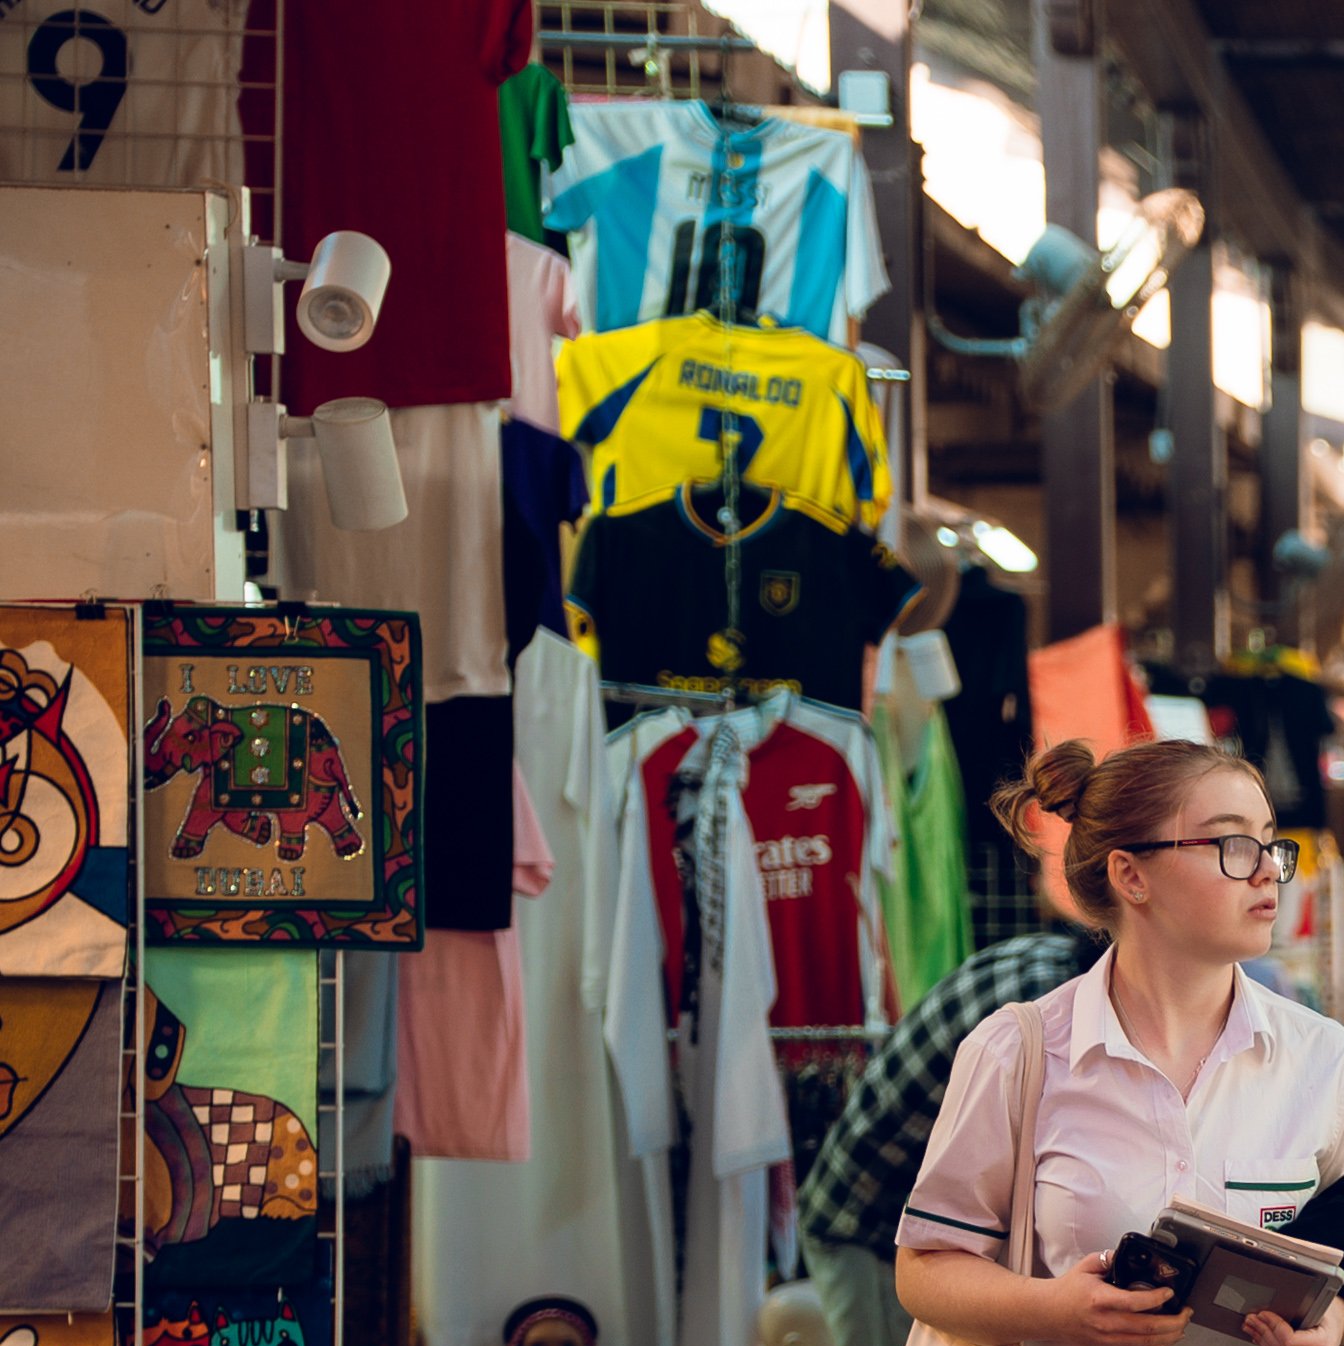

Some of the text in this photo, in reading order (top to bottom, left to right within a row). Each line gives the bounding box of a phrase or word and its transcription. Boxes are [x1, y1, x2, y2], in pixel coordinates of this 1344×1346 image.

[27, 8, 128, 172] 9
[179, 664, 314, 695] I LOVE
[194, 866, 307, 897] DUBAI
[1264, 1210, 1293, 1223] DESS
